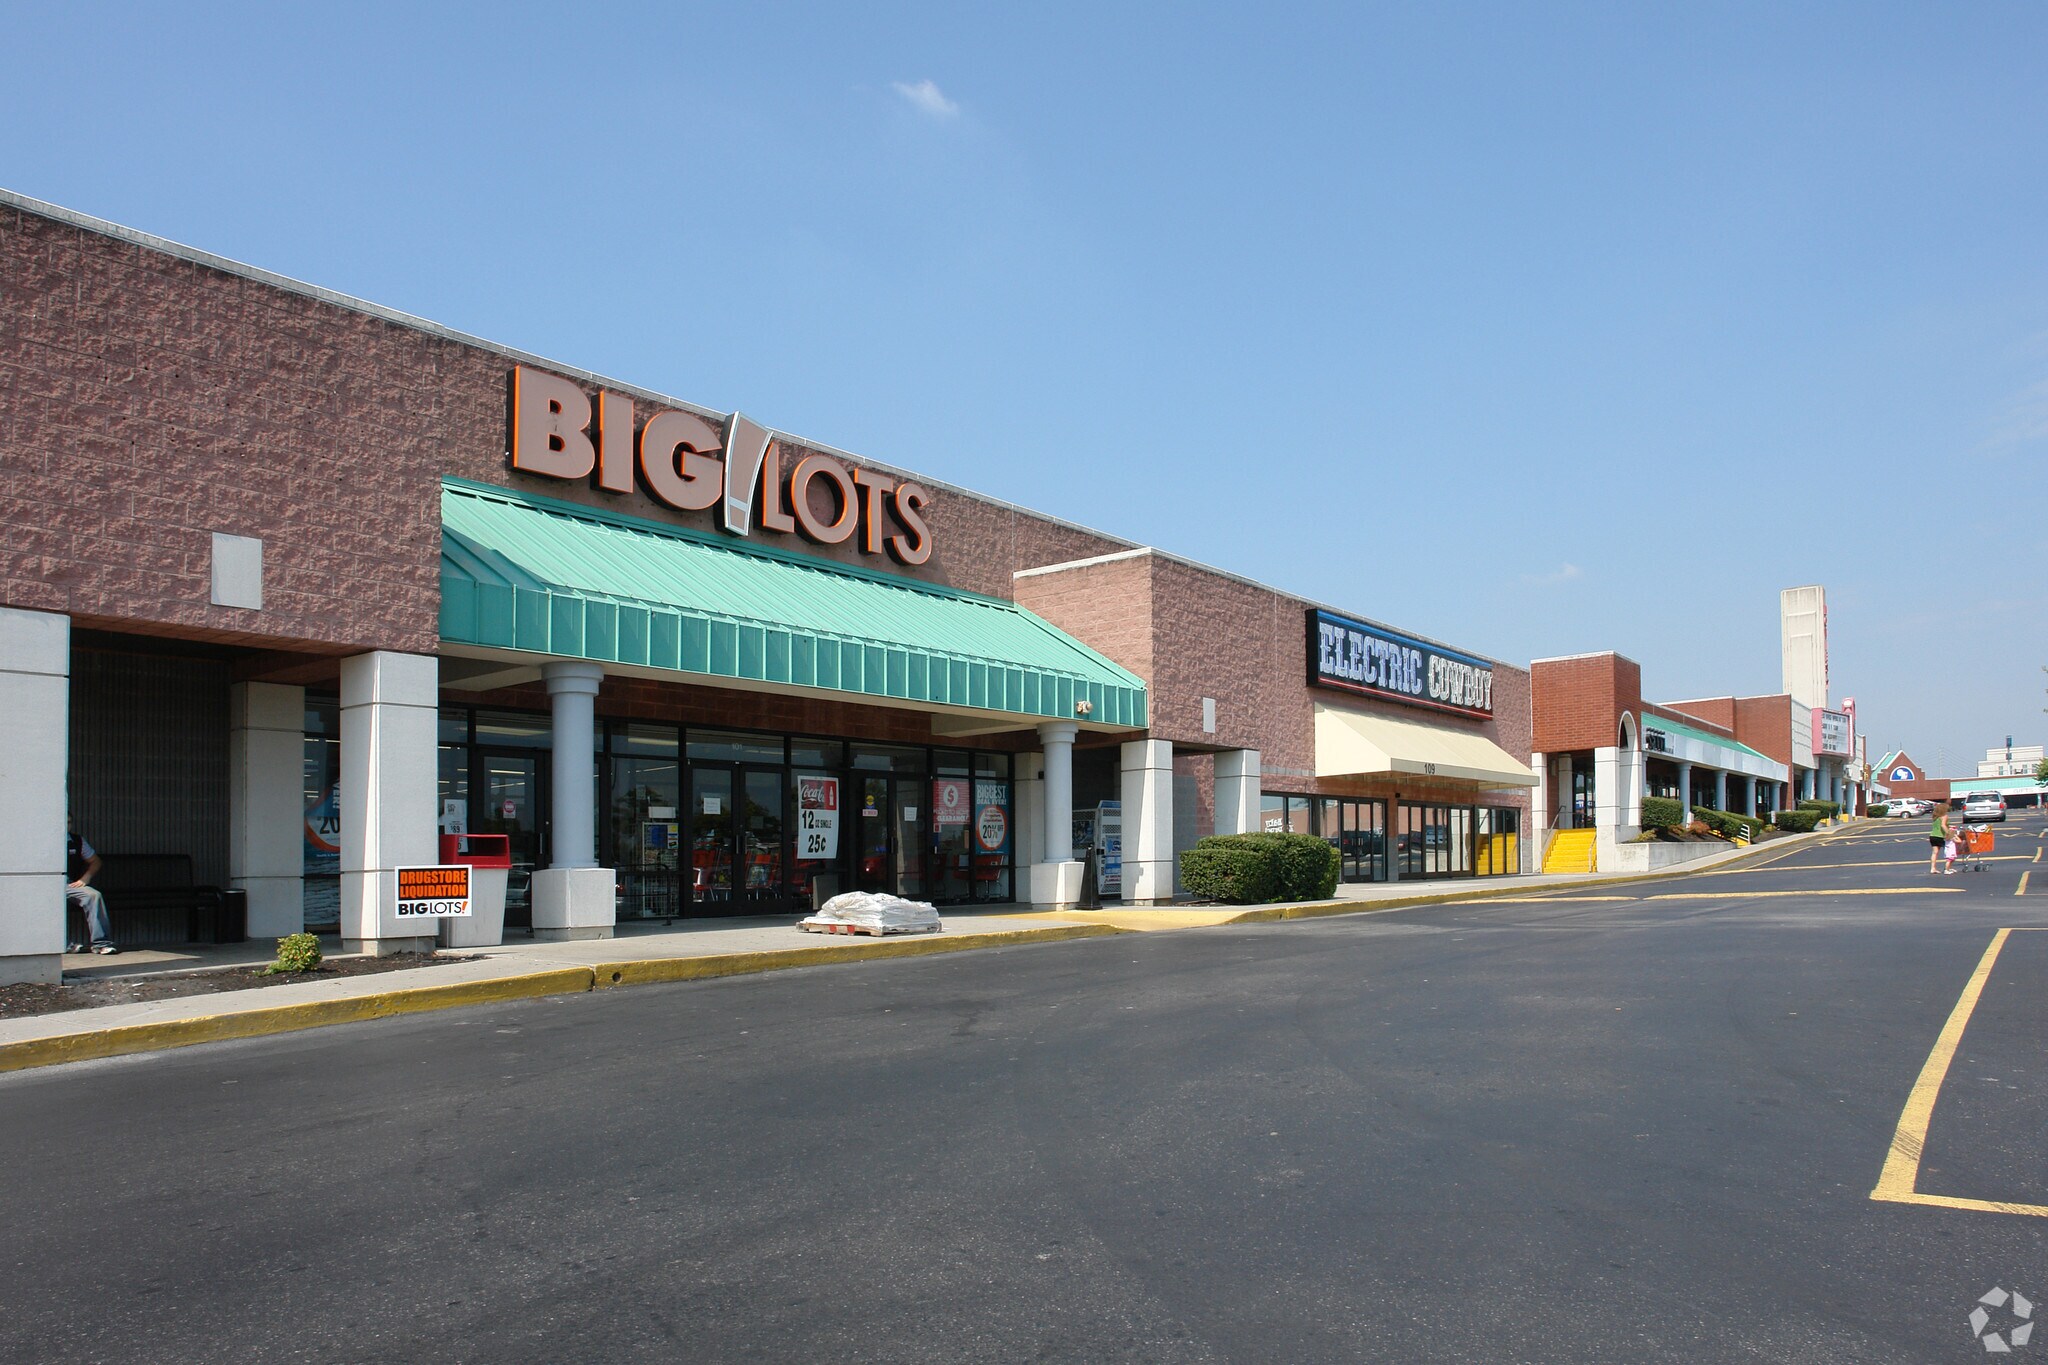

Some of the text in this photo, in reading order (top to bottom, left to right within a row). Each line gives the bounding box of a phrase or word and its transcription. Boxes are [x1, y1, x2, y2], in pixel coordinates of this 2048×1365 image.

[1319, 622, 1493, 711] ELECTRIC COWBOY
[1424, 762, 1436, 775] 109
[976, 784, 1007, 799] BIGGEST
[802, 810, 814, 829] 12
[400, 870, 467, 885] DRUGSTORE
[400, 884, 467, 899] LIQUIDATION
